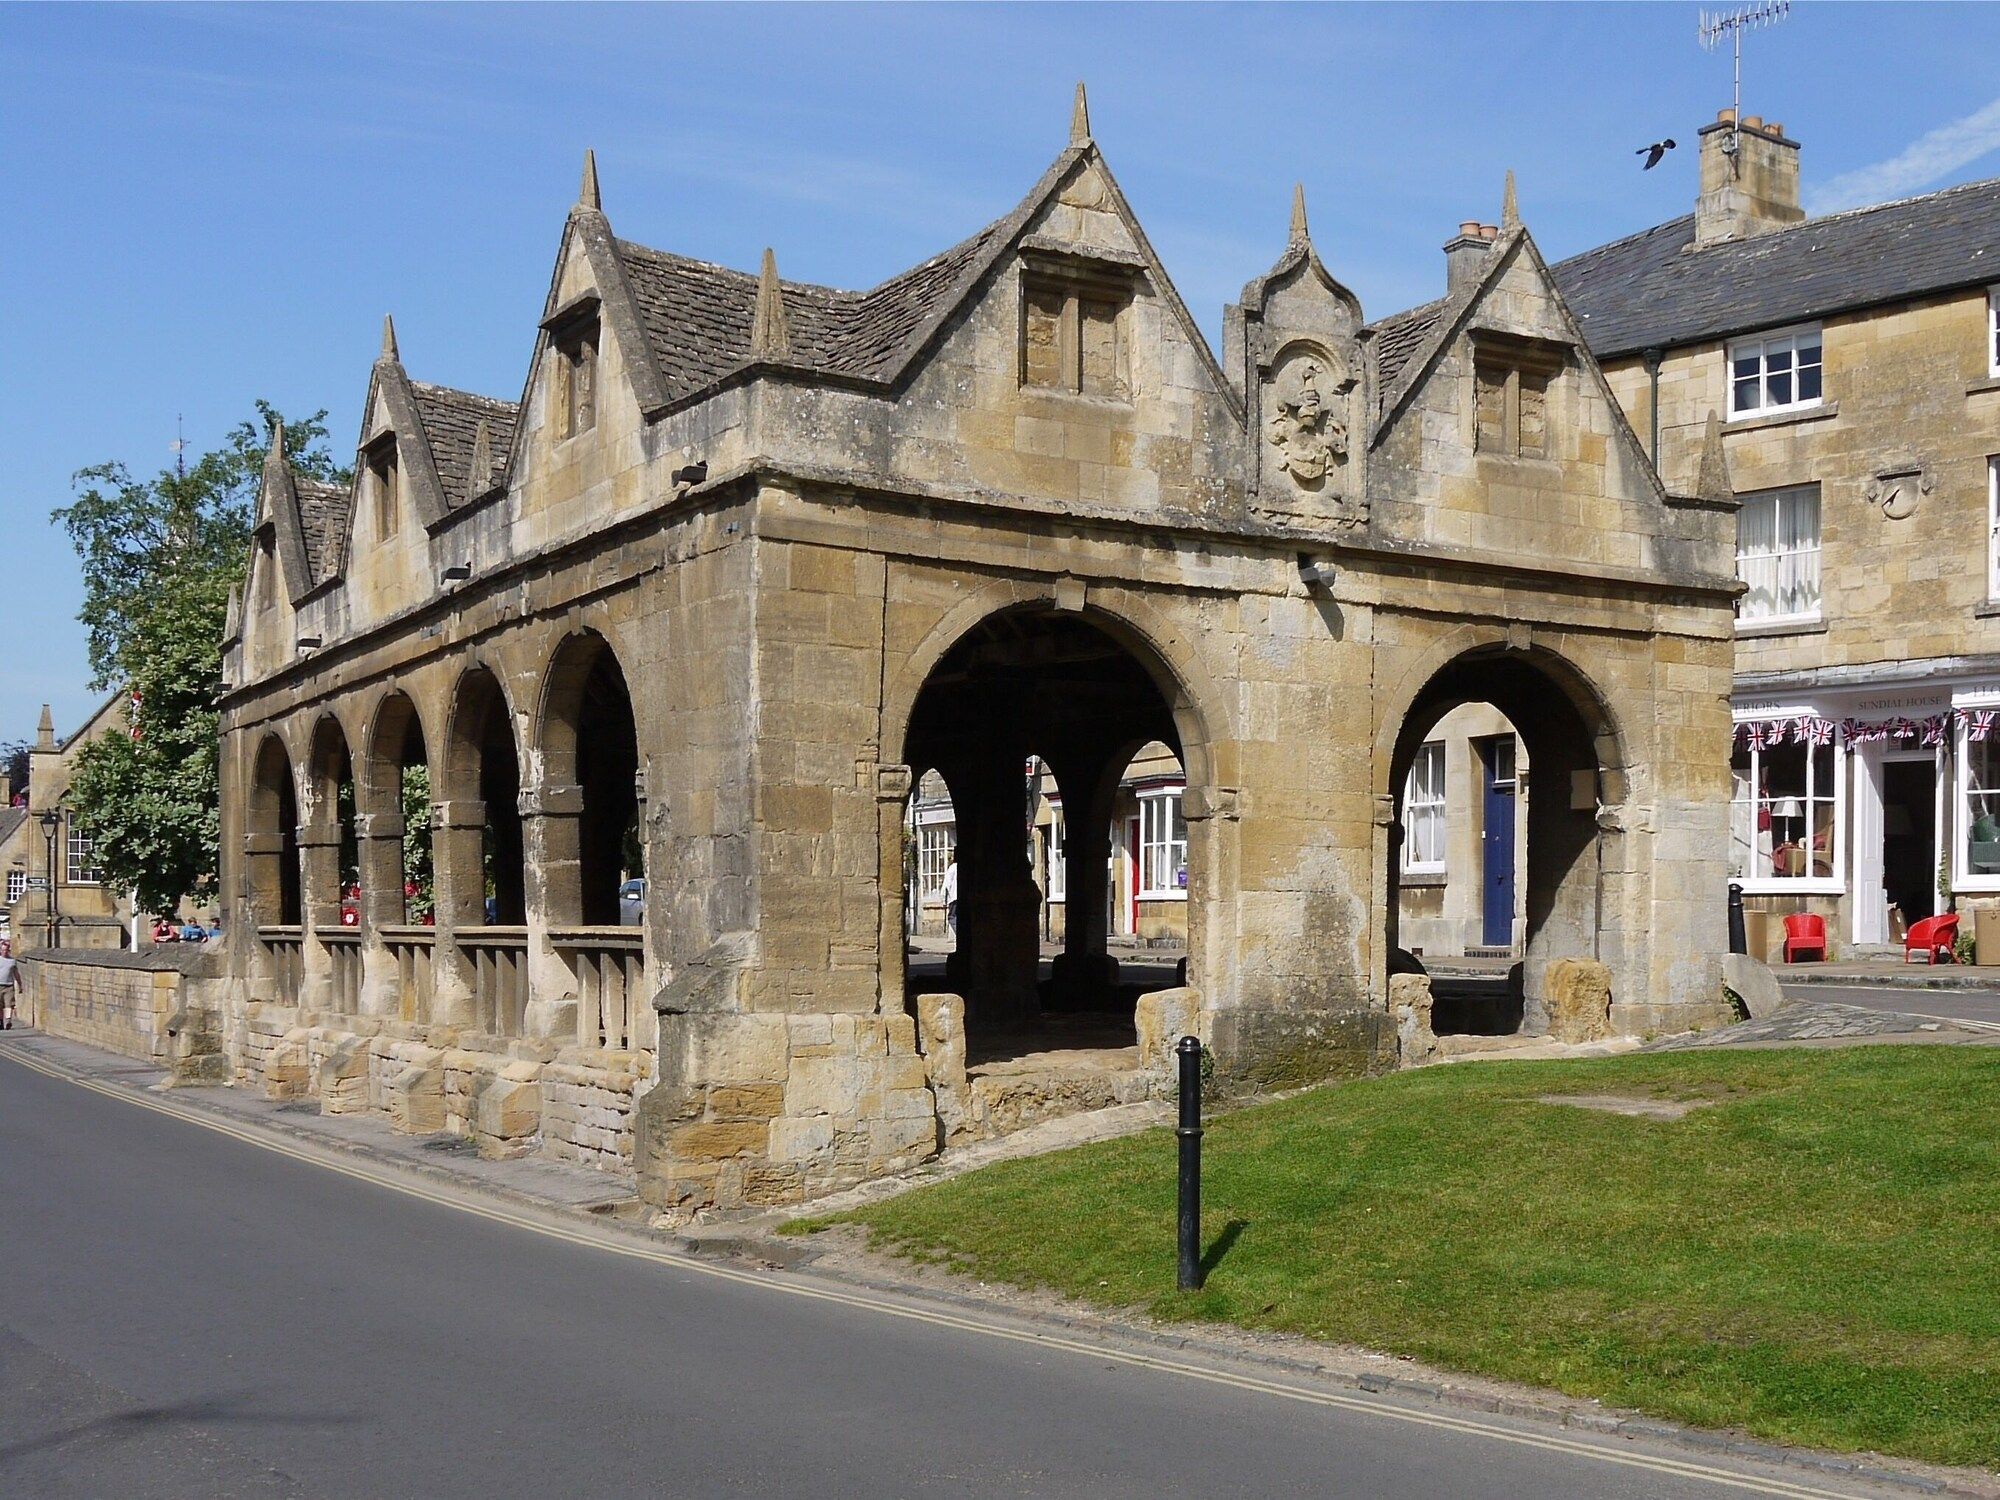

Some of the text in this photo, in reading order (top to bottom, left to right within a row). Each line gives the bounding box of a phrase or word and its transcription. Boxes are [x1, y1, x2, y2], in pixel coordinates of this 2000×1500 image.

[1732, 701, 1780, 714] ERIORS
[1858, 695, 1942, 711] SUNDIAL HOUSE
